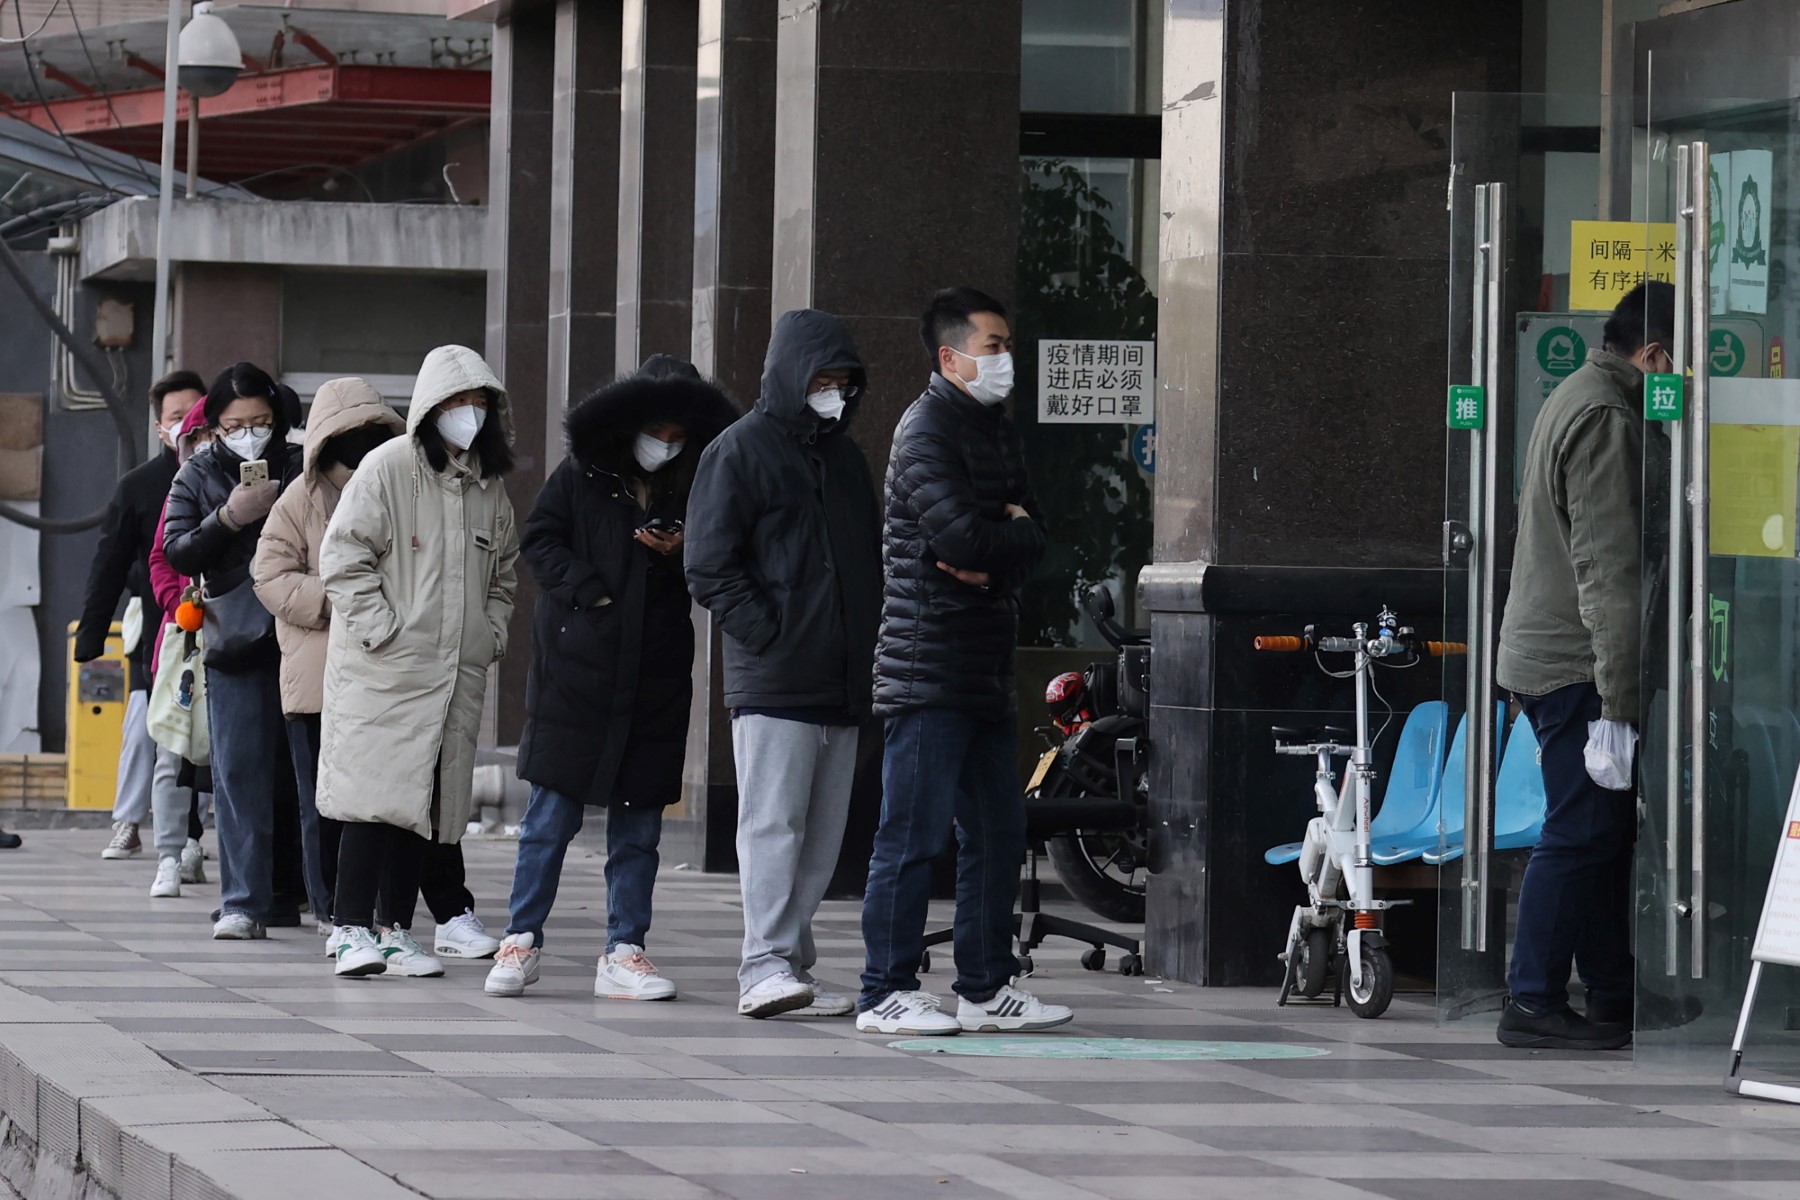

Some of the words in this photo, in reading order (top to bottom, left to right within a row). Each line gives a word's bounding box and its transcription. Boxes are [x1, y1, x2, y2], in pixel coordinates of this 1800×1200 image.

[1591, 238, 1676, 263] 间隔一米
[1047, 344, 1143, 366] 疫情期间
[1047, 368, 1143, 390] 进店必须
[1046, 394, 1143, 417] 戴好口罩
[1456, 398, 1477, 419] 推
[1652, 386, 1676, 410] 拉
